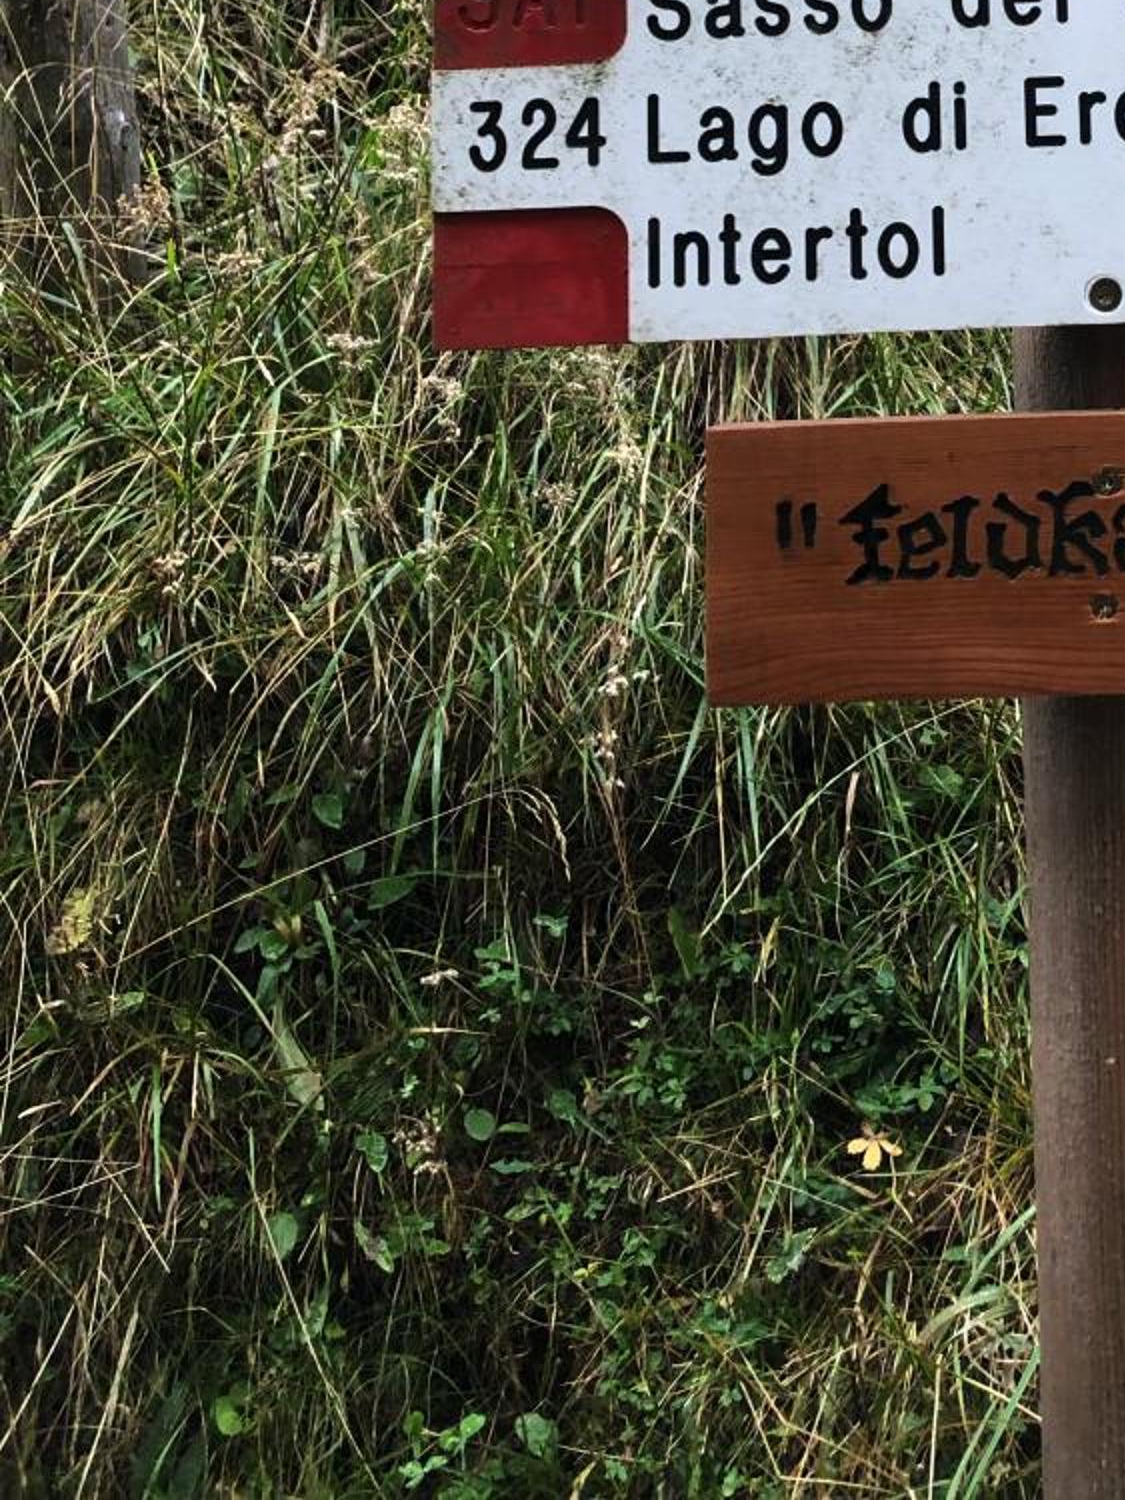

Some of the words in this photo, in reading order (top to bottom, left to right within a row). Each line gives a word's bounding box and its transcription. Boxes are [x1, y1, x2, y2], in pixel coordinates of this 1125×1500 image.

[469, 96, 607, 173] 324
[647, 93, 844, 177] Lago
[902, 81, 967, 154] di
[647, 205, 945, 289] Intertol
